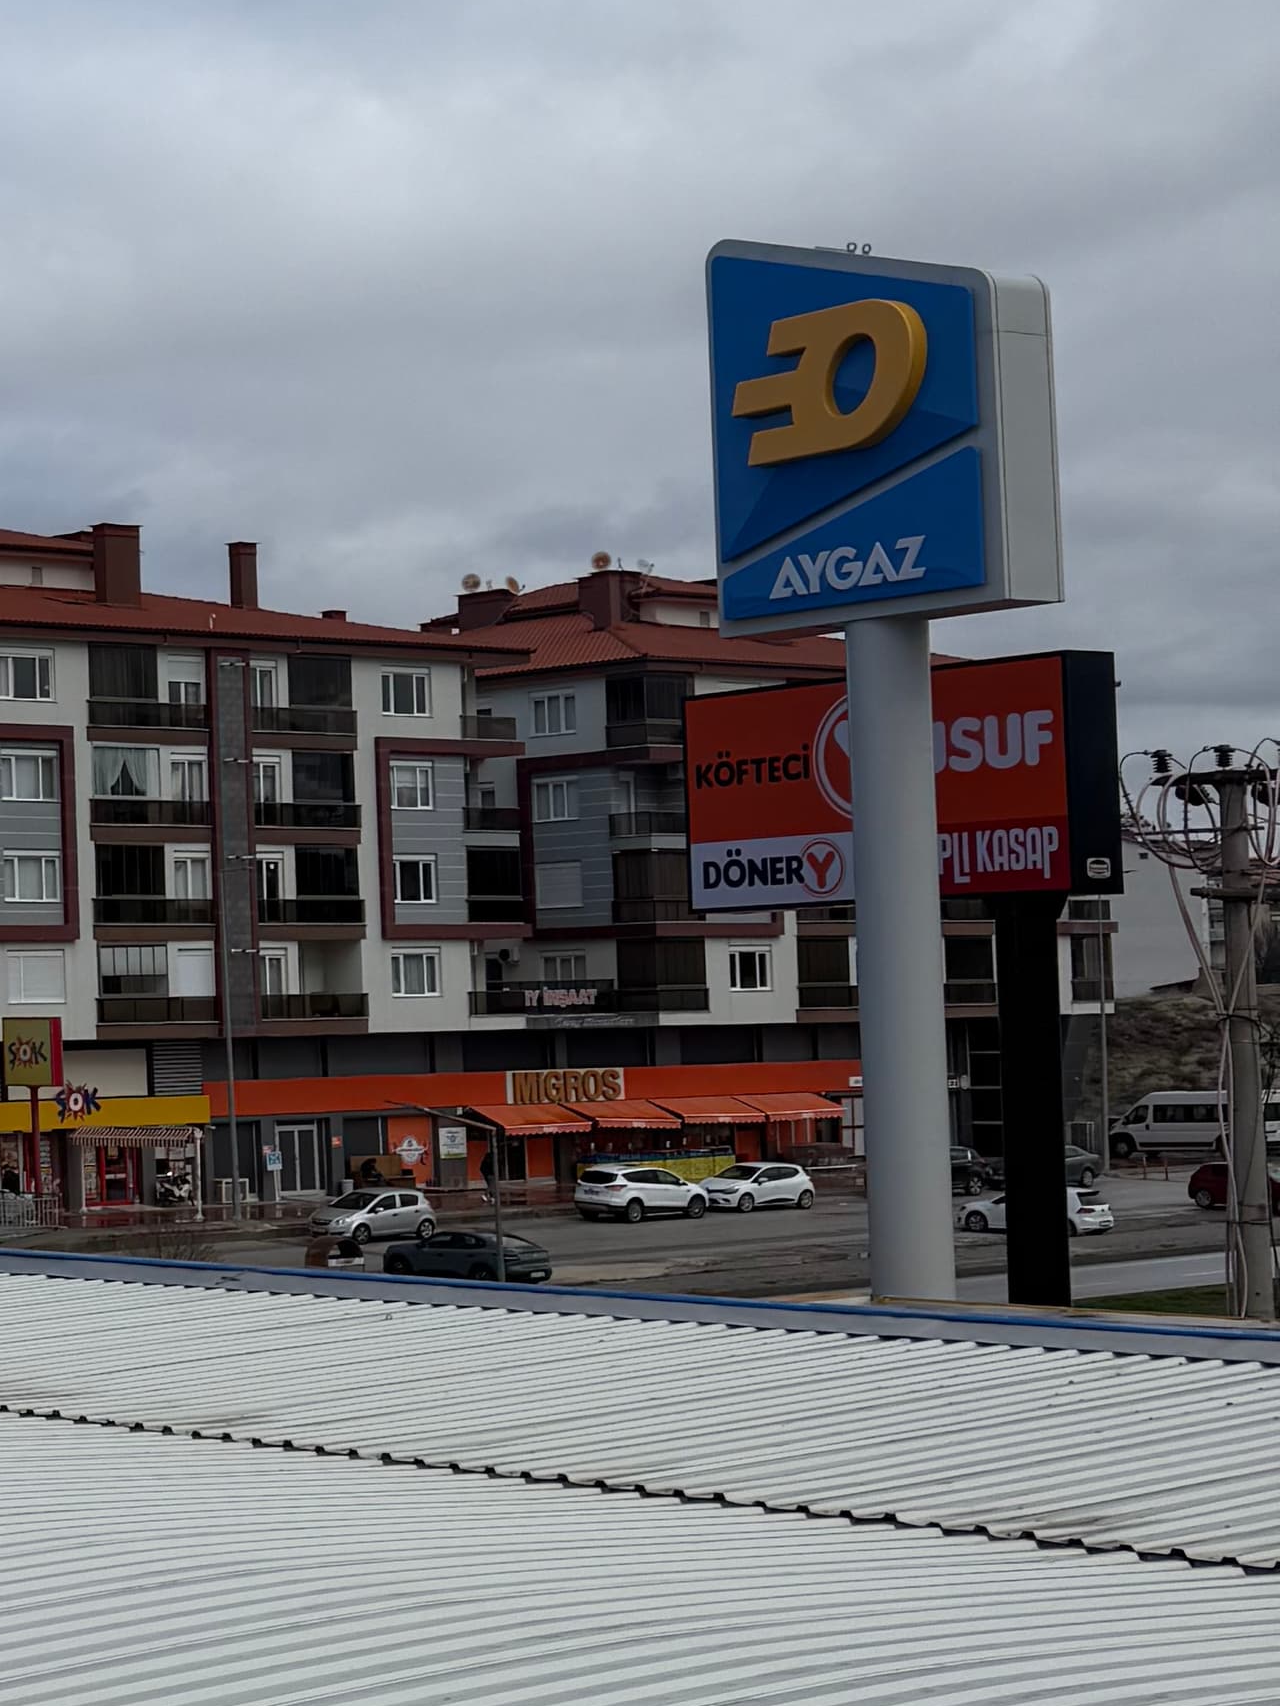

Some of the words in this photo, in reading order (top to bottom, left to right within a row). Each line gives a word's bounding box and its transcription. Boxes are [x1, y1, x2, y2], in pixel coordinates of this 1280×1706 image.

[769, 534, 927, 600] AYGAZ
[695, 743, 810, 789] KÖFTECİ
[703, 848, 804, 890] DÖNER
[976, 825, 1059, 880] KASAP
